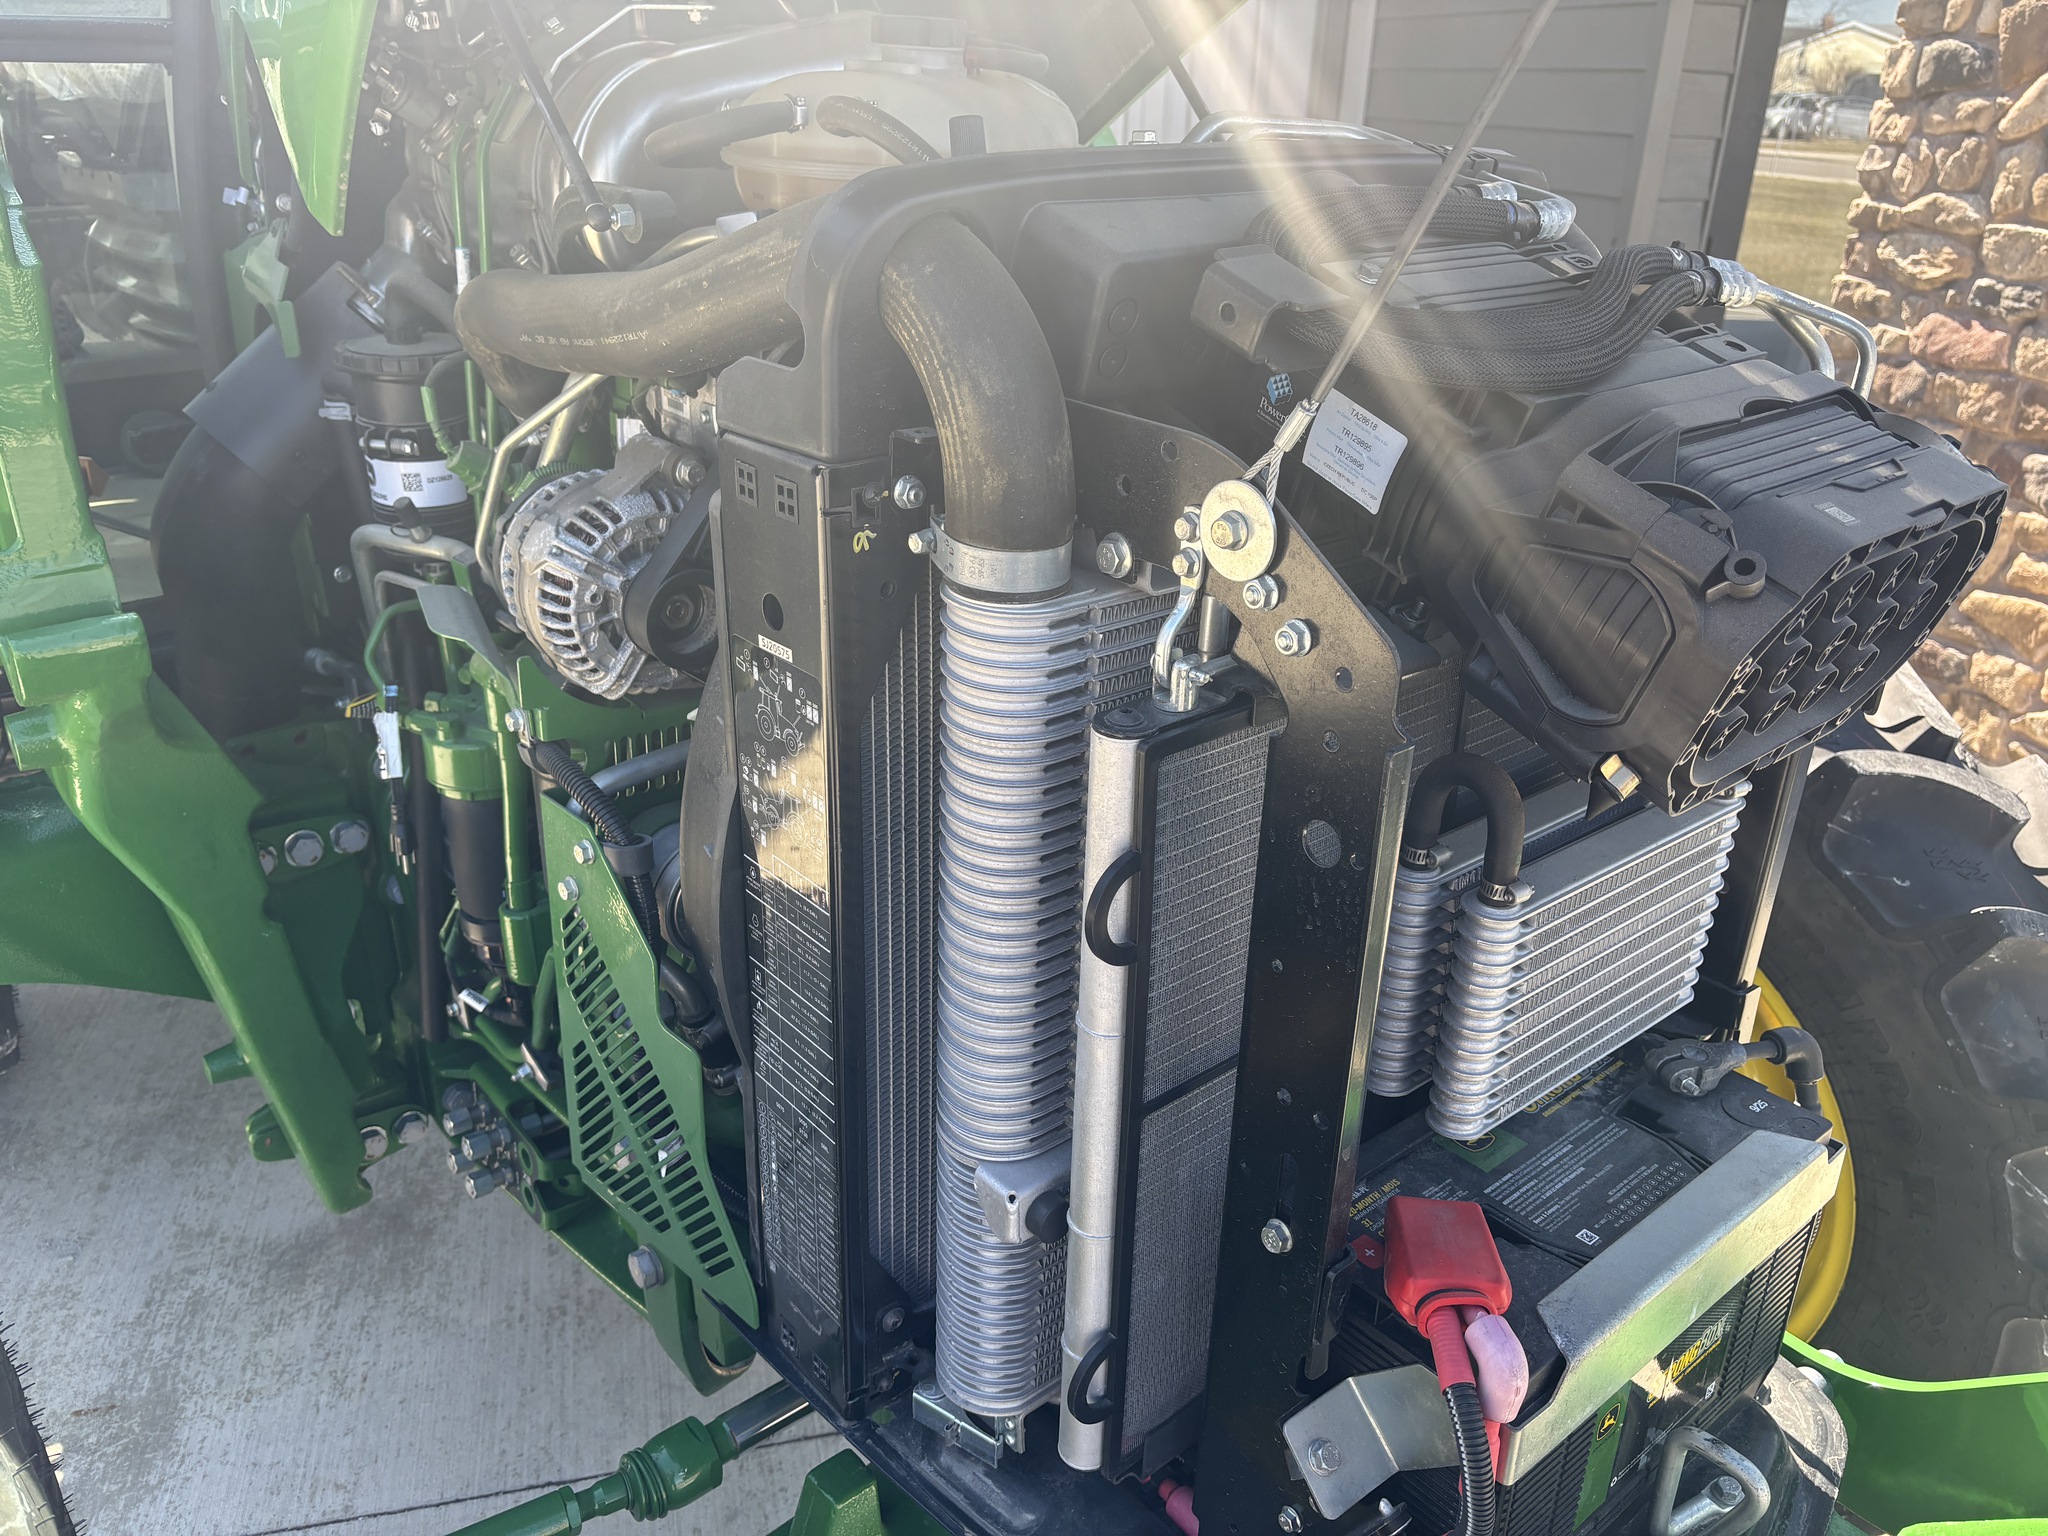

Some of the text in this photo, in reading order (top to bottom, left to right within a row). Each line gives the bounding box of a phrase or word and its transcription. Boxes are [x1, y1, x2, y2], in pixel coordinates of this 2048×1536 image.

[1339, 426, 1373, 453] TR129895
[761, 637, 790, 660] SJ20575
[1361, 1218, 1374, 1228] 31
